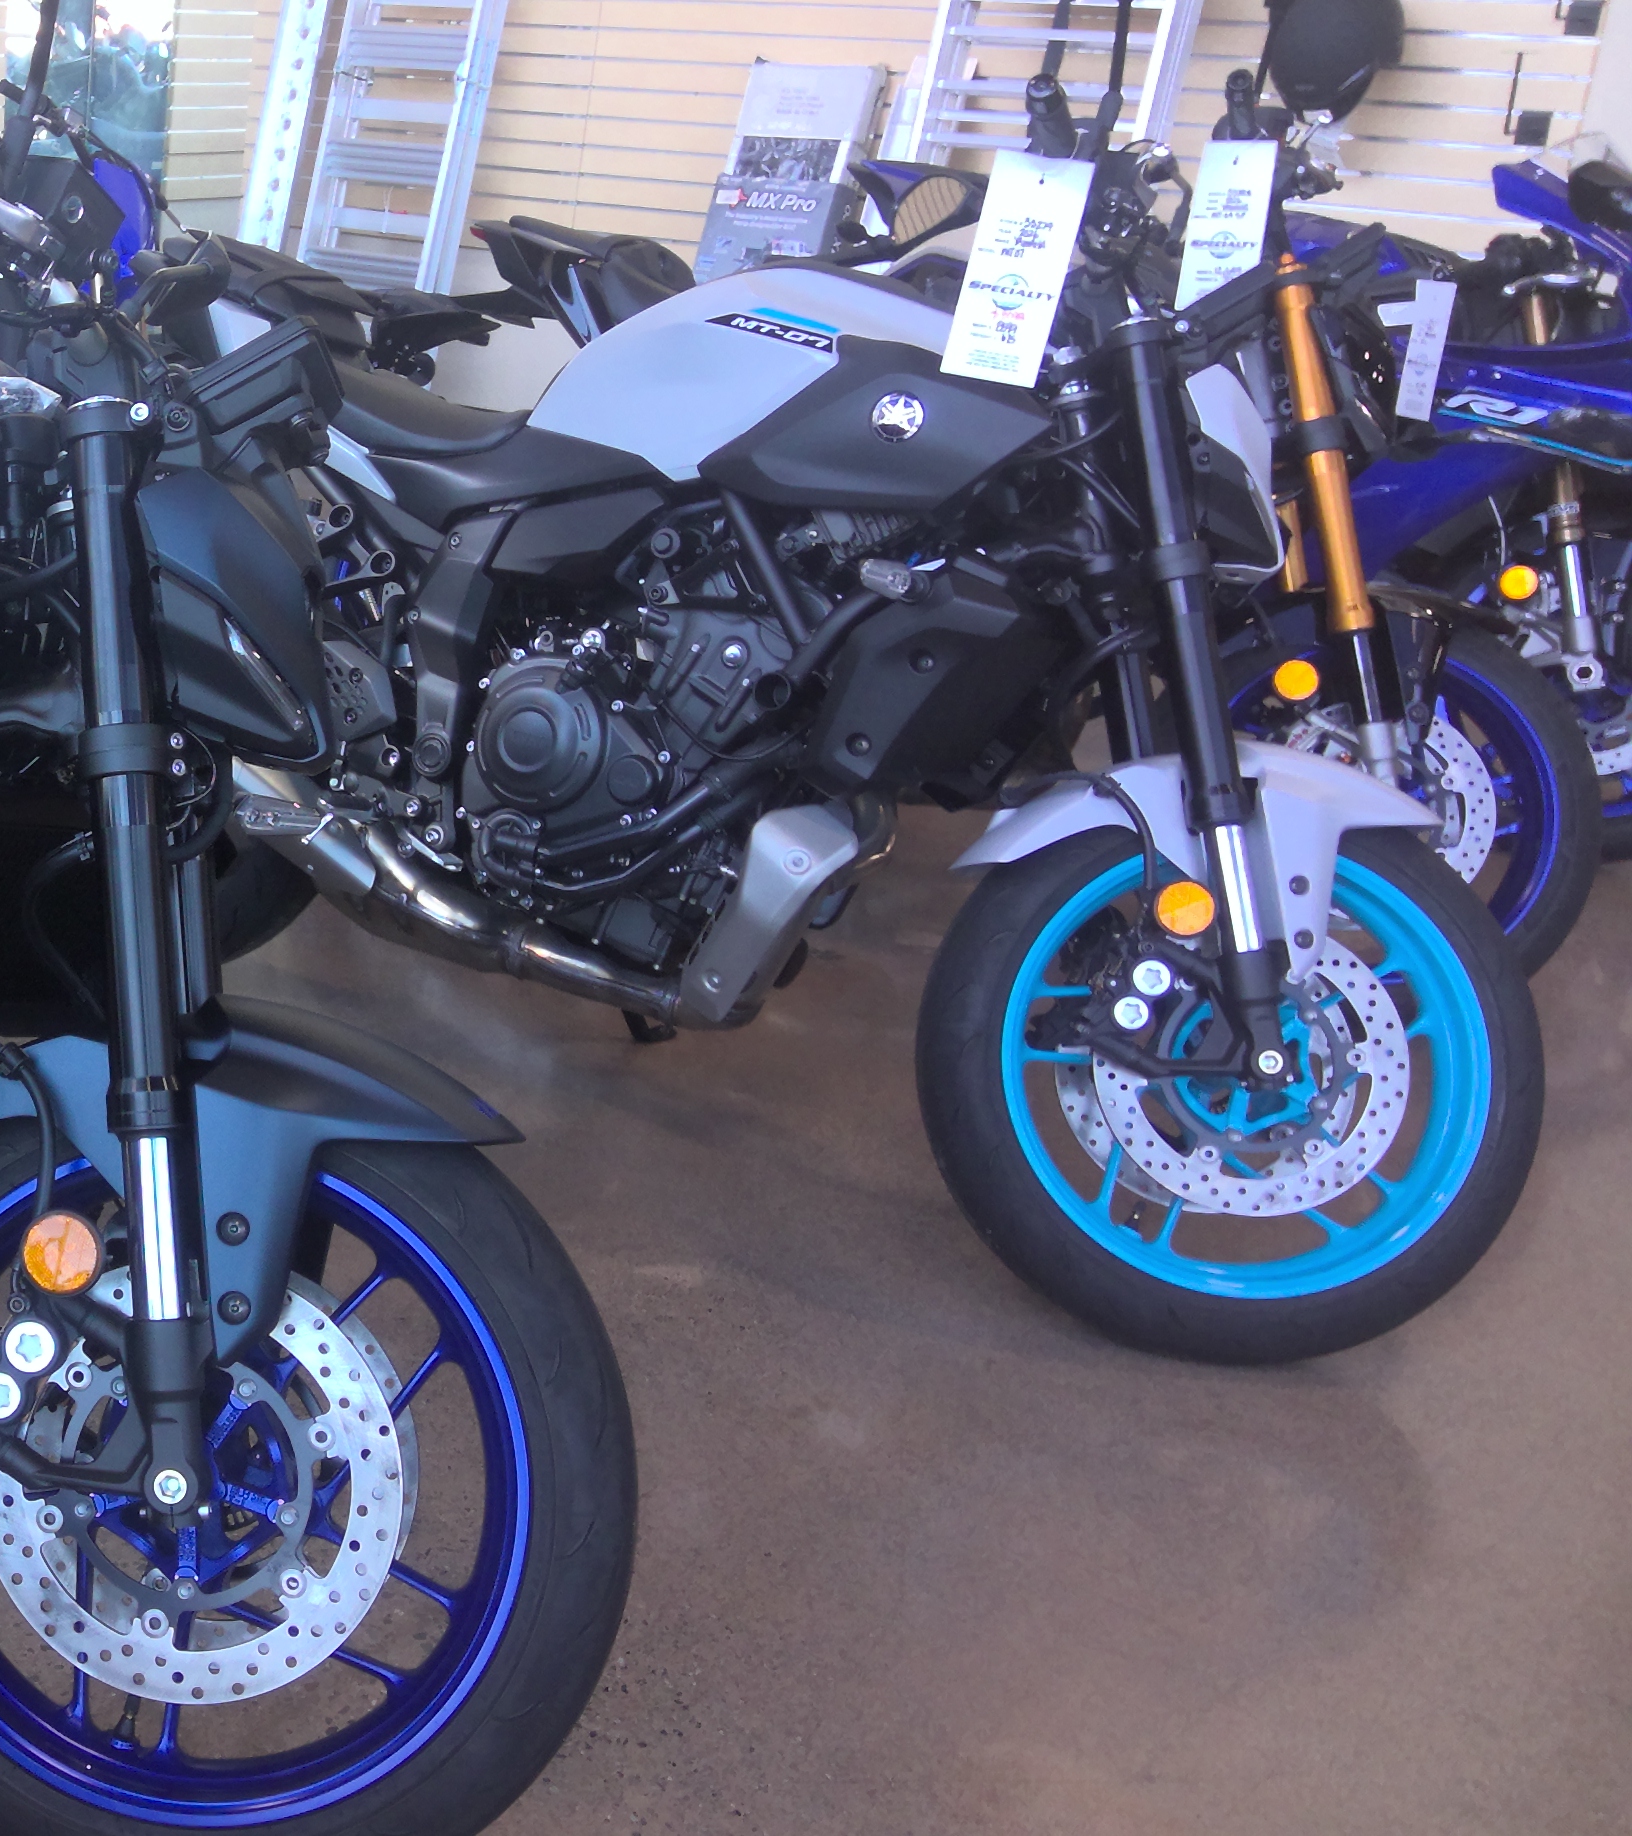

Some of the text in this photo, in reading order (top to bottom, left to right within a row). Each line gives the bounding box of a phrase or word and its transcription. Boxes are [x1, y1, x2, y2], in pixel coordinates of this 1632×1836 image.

[745, 191, 817, 212] MX Pro
[968, 280, 1055, 301] SPECIALTY
[730, 316, 831, 348] MT-07
